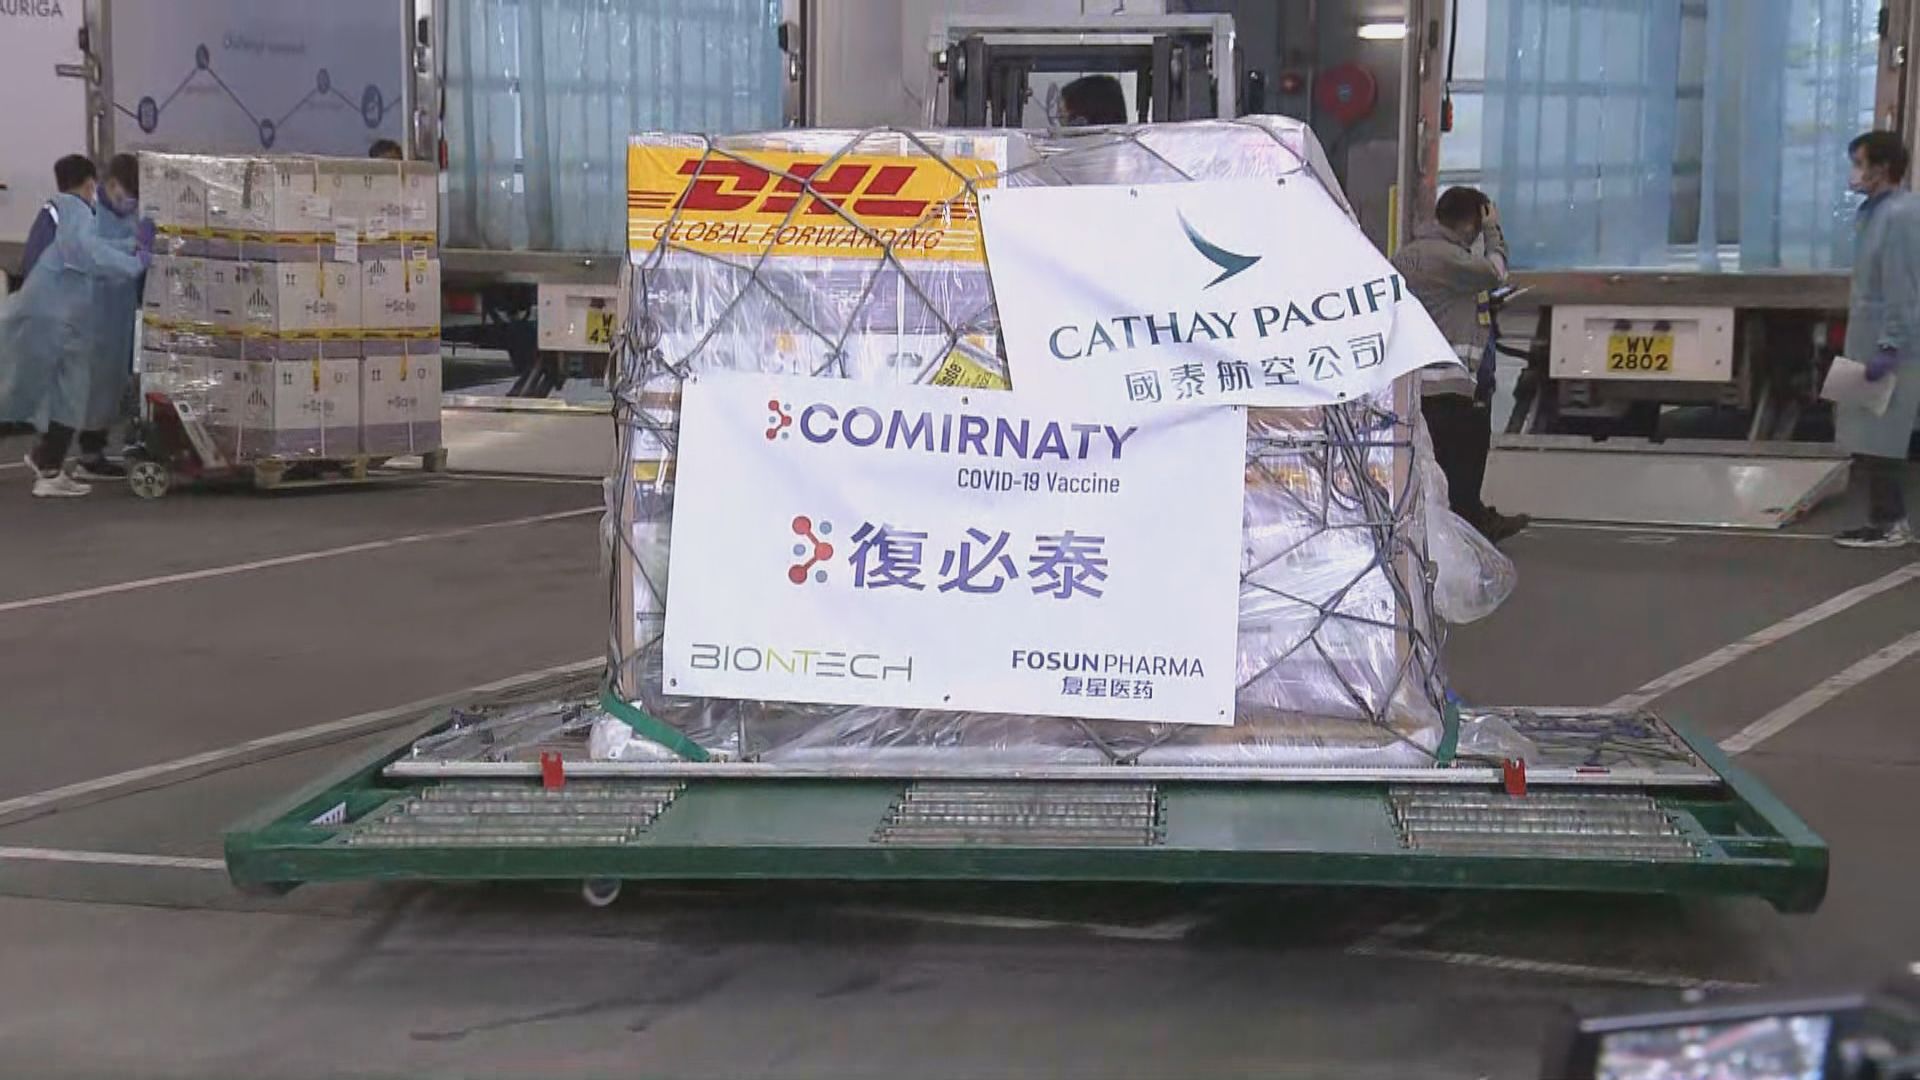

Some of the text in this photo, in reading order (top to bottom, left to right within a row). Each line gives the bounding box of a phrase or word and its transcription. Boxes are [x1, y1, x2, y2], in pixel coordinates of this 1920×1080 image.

[671, 159, 930, 217] DHL
[652, 221, 944, 251] GLOBAL FORWARDING
[1049, 311, 1237, 360] CATHAY
[1627, 337, 1655, 353] WV
[1124, 332, 1385, 403] 國泰航空公司
[1611, 354, 1668, 371] 2802
[800, 402, 1139, 459] COMIRNATY
[957, 468, 1121, 494] COVID-19 Vaccine
[848, 521, 1108, 600] 復必泰
[690, 643, 913, 682] BIONTECH
[1012, 650, 1205, 678] FOSUN PHARMA
